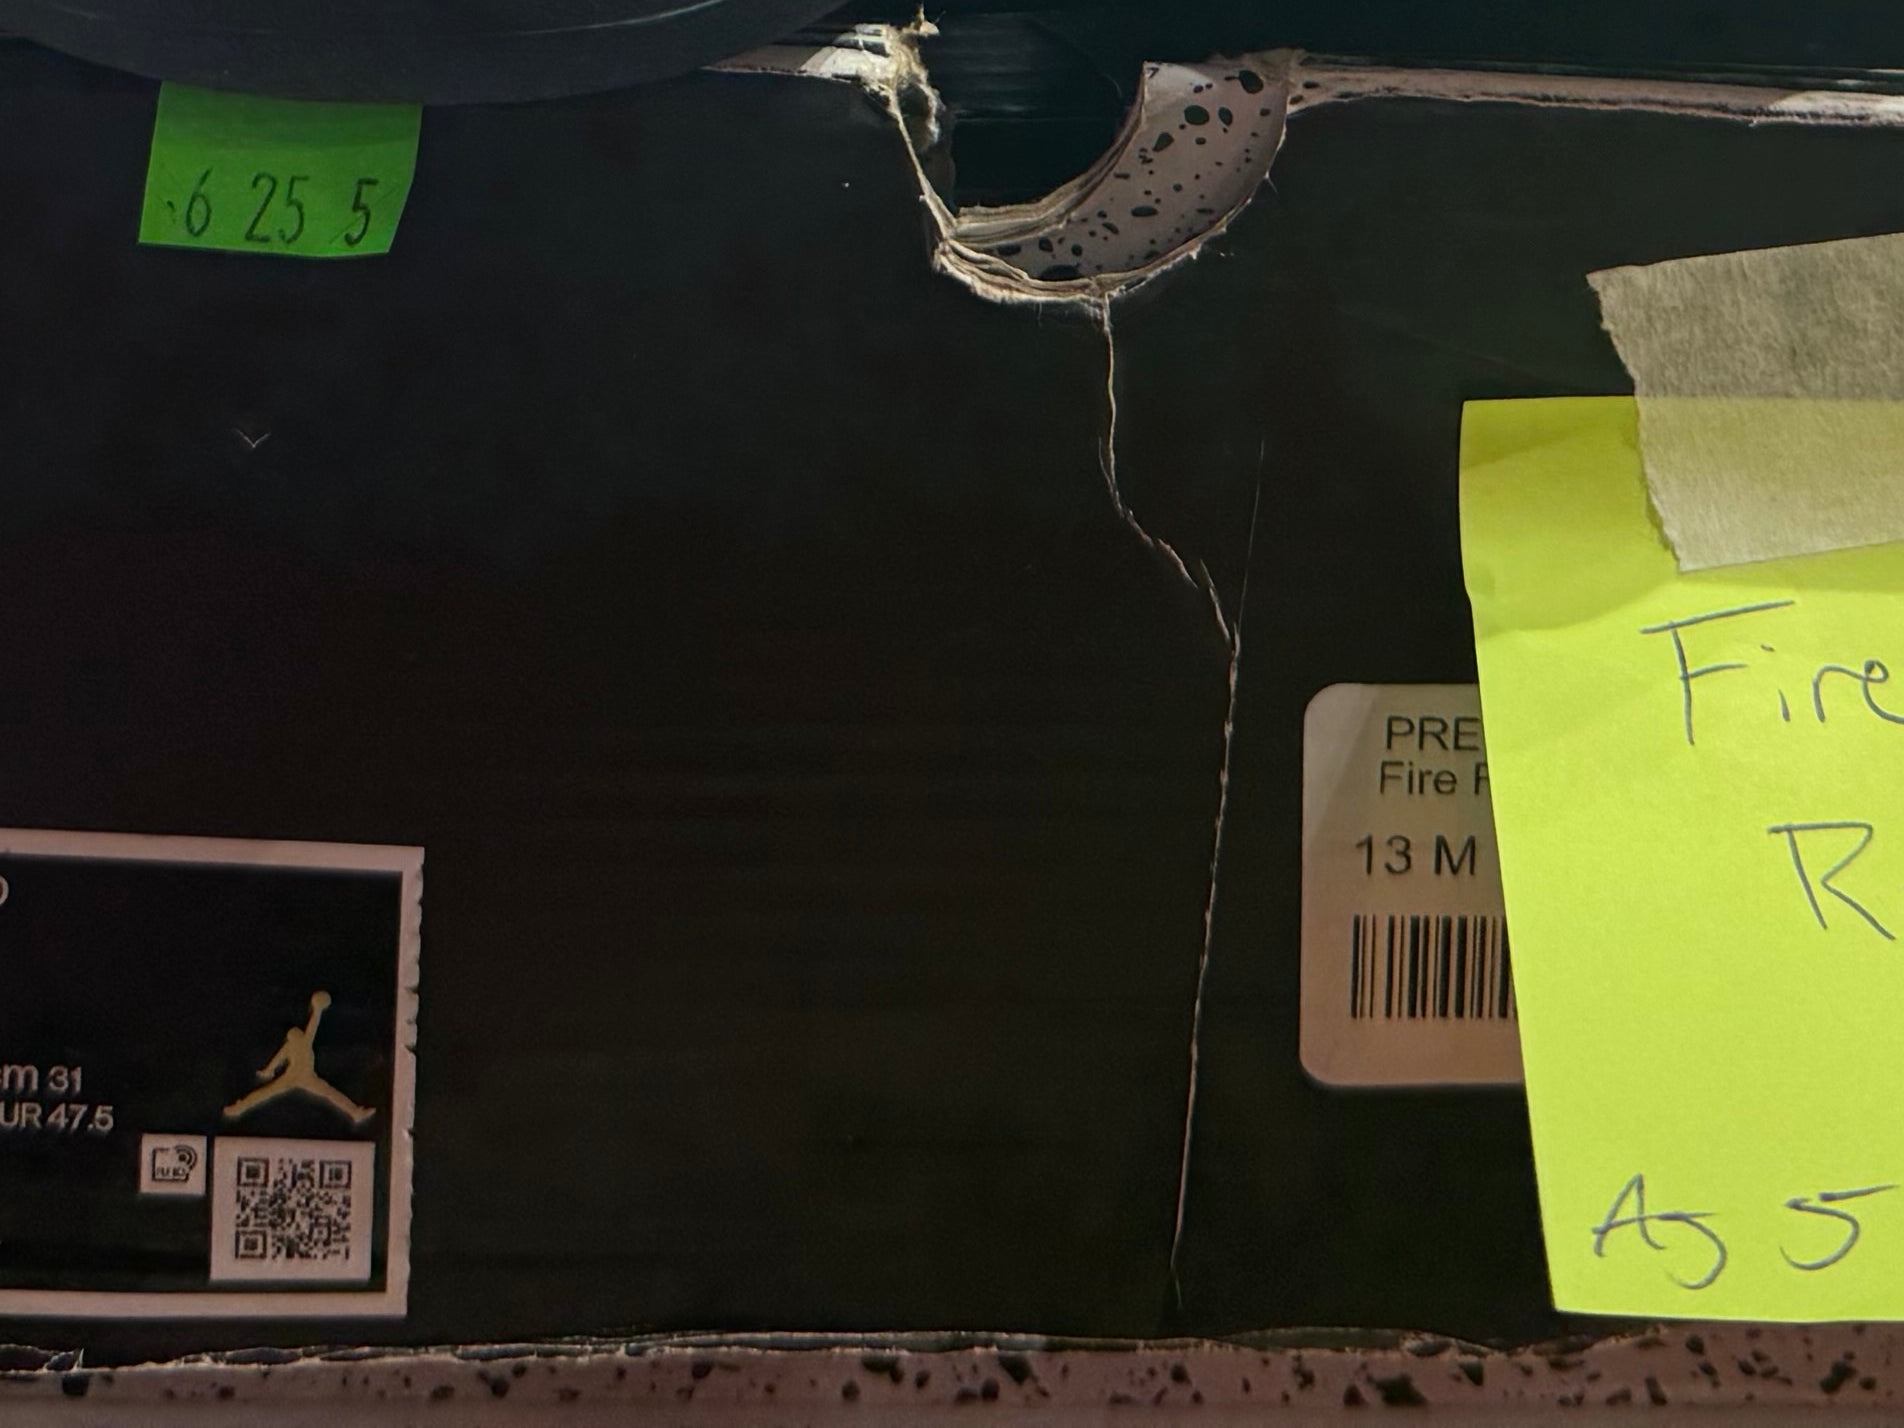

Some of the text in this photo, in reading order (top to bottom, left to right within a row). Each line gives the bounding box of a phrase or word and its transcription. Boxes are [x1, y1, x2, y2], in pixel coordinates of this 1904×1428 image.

[1385, 715, 1482, 752] PRE
[1379, 760, 1458, 796] Fire
[1355, 834, 1477, 876] 13 M
[47, 1065, 83, 1095] 31
[44, 1101, 115, 1132] 47.5
[1779, 1183, 1901, 1272] 5
